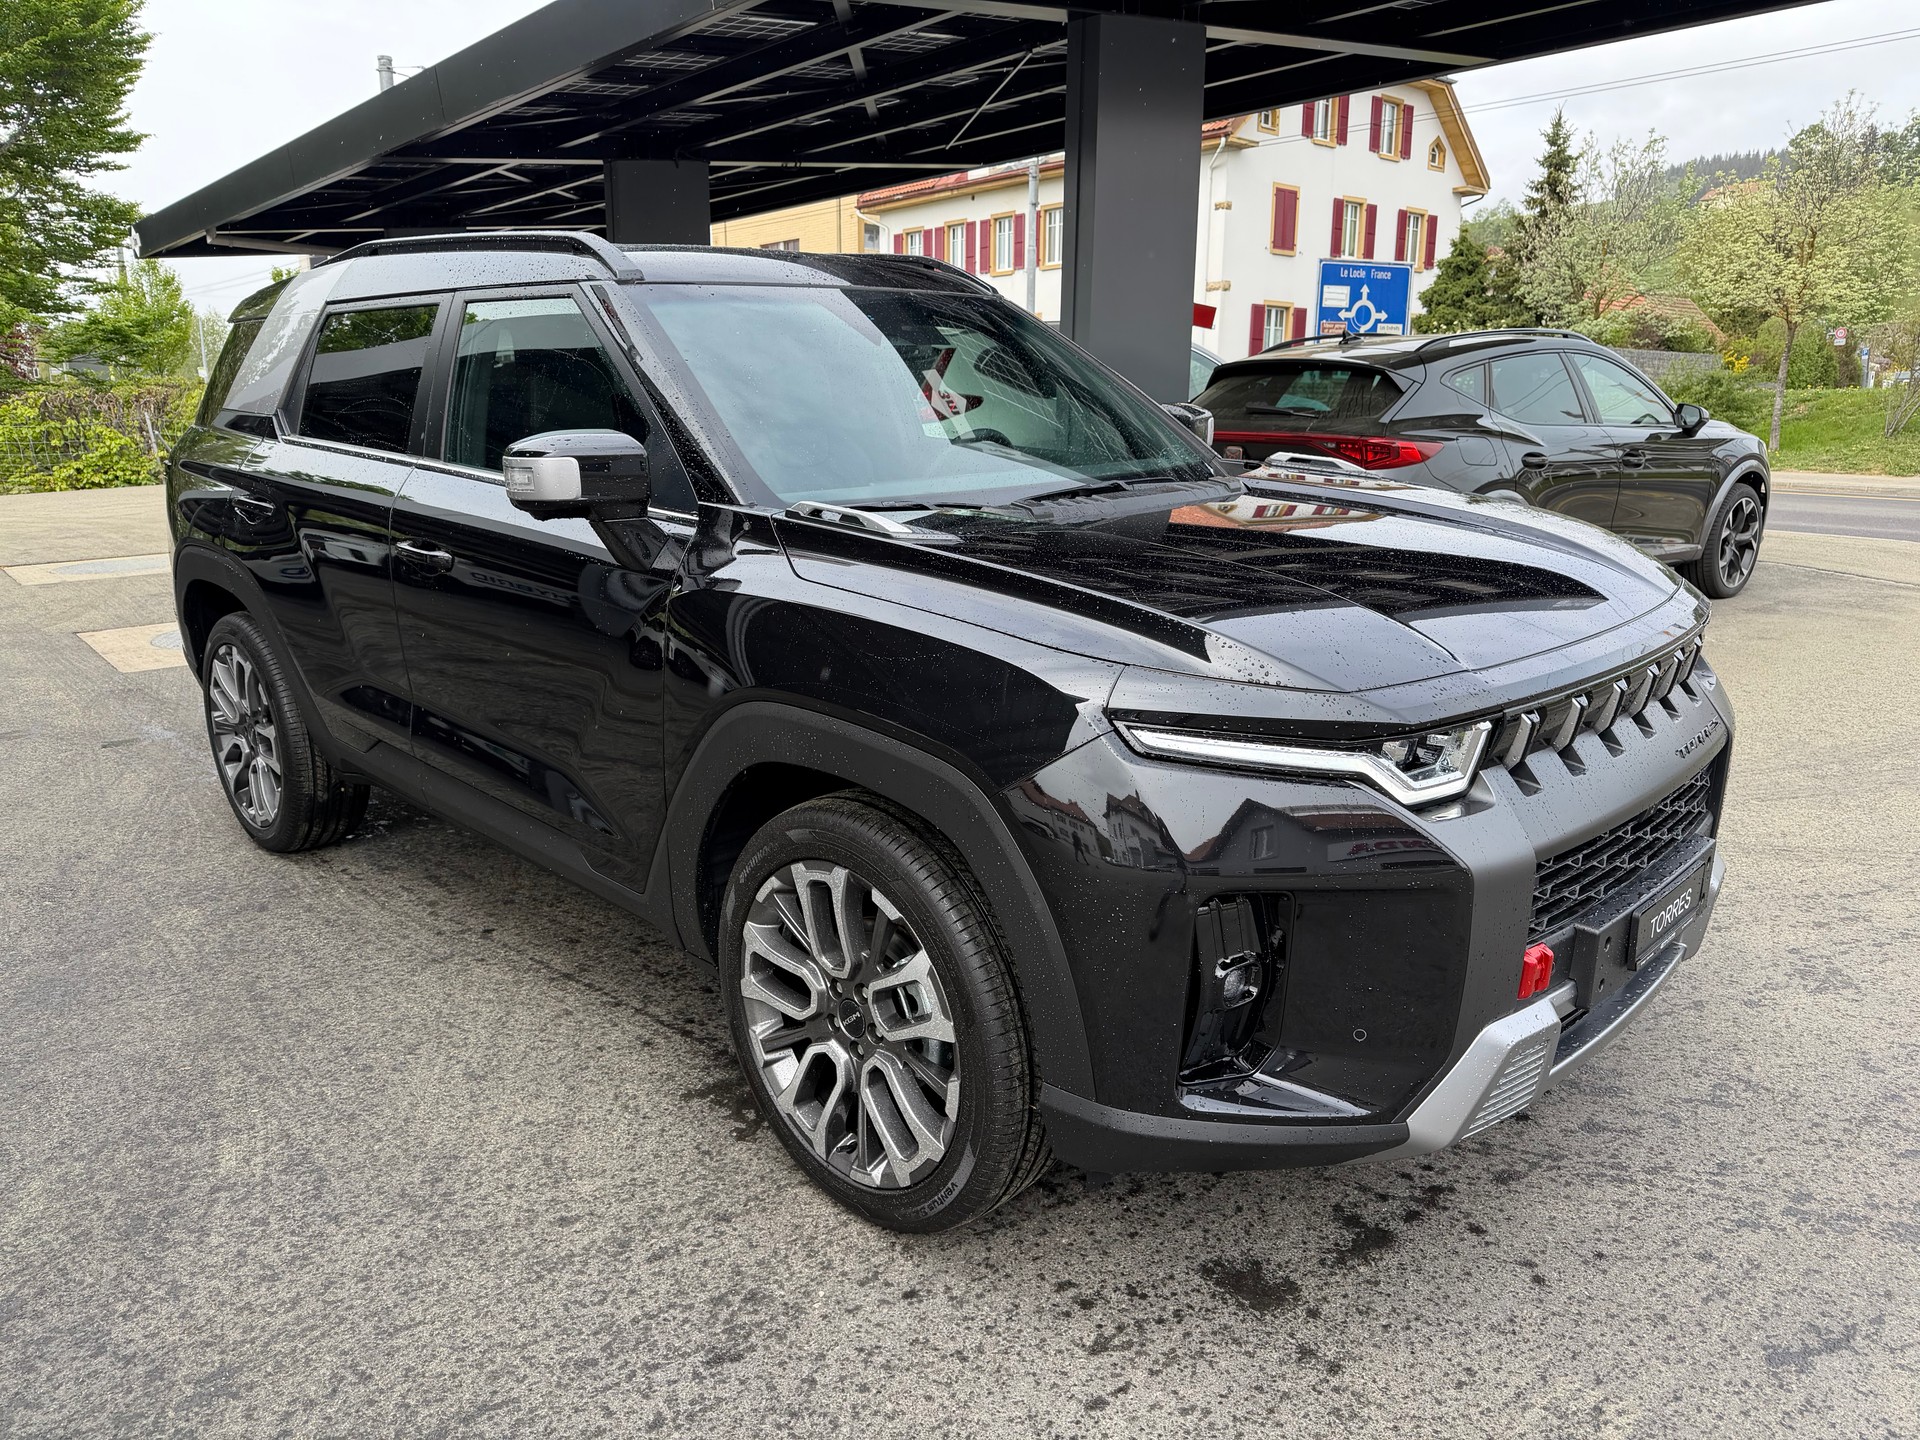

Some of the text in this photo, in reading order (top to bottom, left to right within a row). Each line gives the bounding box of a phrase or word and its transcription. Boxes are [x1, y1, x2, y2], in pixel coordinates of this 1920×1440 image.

[1340, 267, 1392, 280] Le Locle France
[1651, 887, 1693, 939] TORRES
[842, 1011, 861, 1027] KGM
